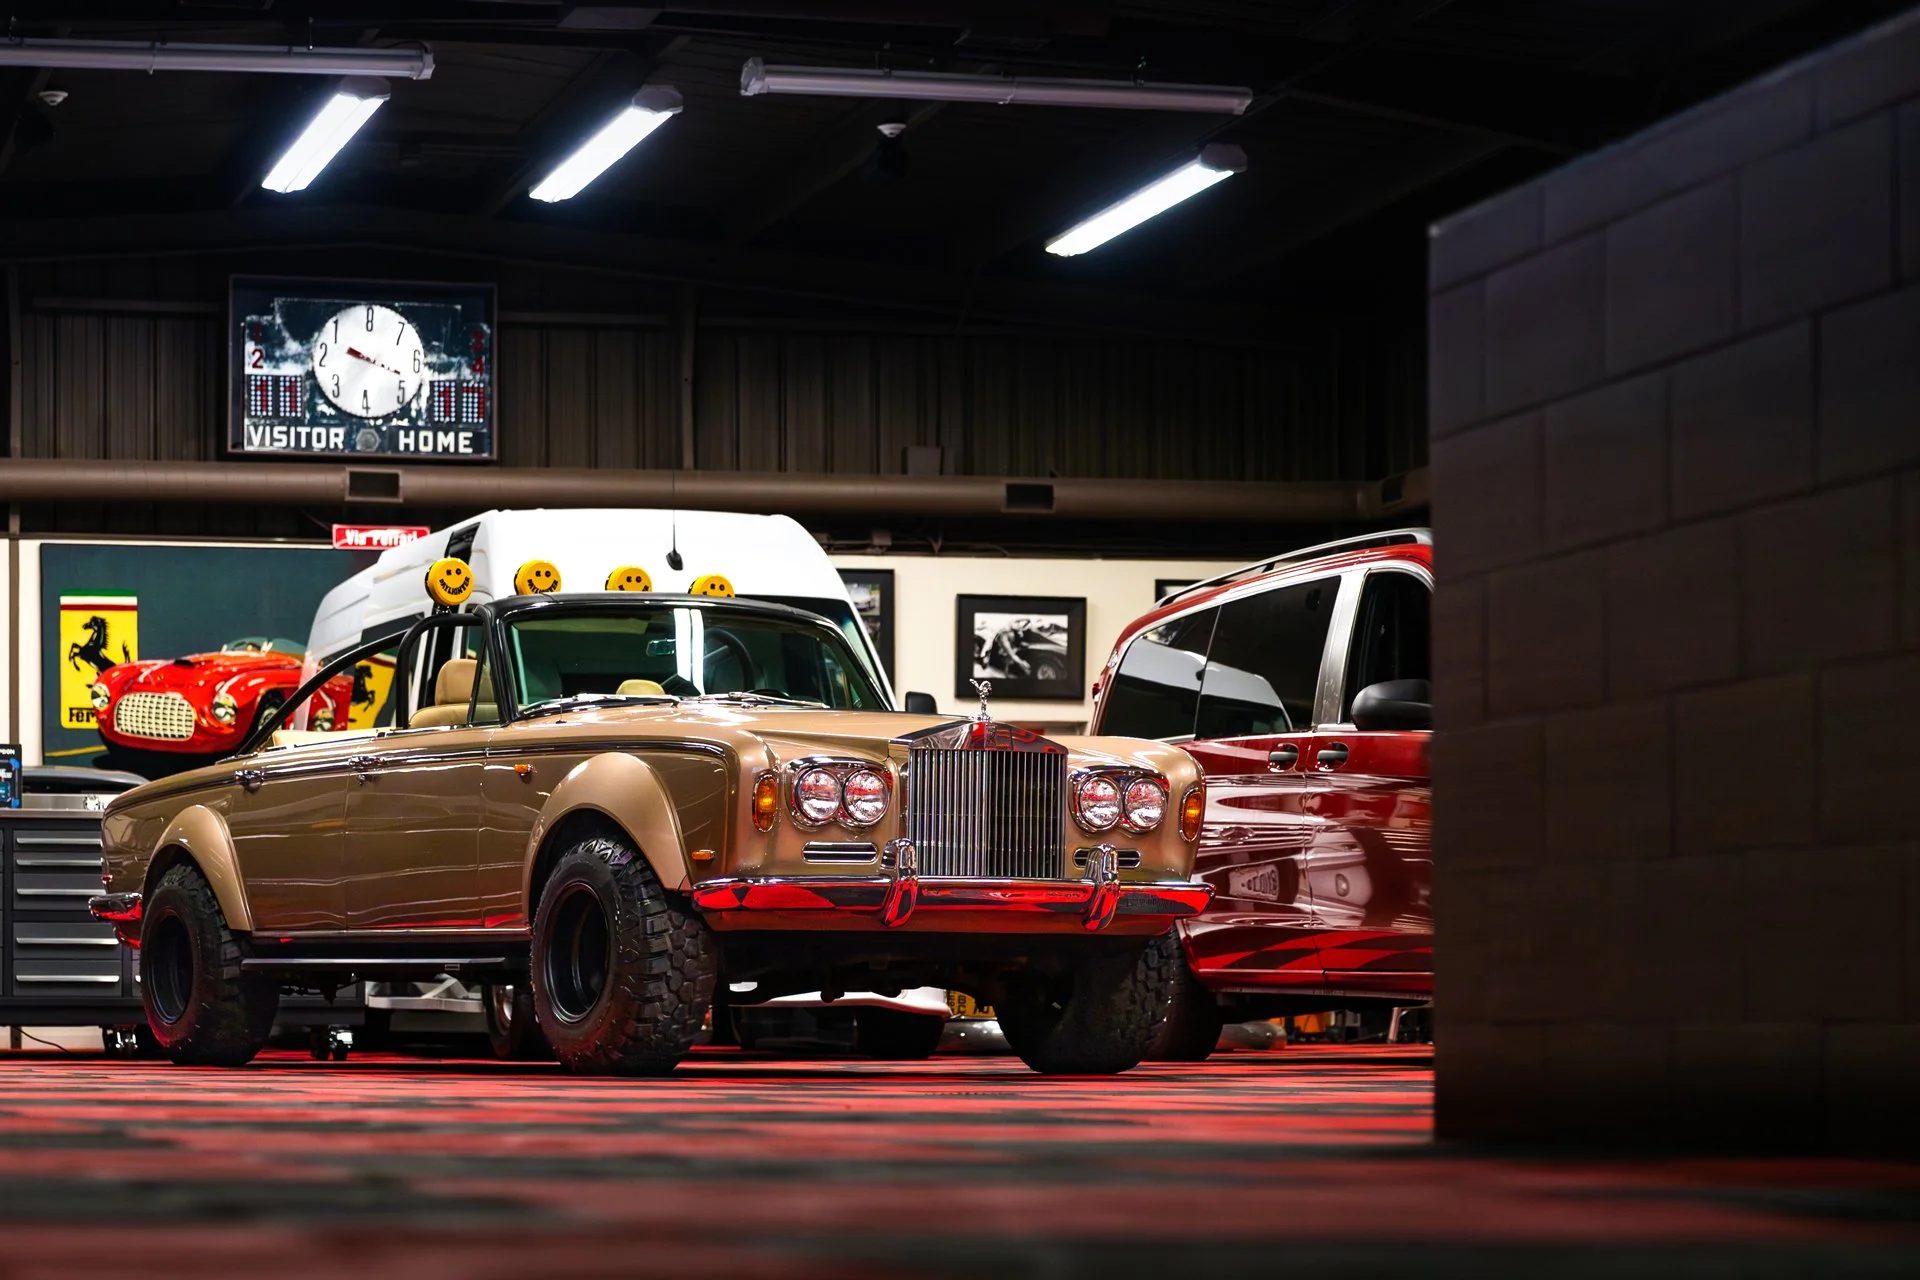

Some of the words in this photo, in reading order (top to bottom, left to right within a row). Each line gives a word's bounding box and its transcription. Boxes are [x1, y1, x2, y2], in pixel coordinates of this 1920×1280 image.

[333, 318, 339, 344] 1
[366, 306, 374, 332] 8
[396, 321, 405, 346] 7
[252, 349, 264, 369] 2
[318, 342, 328, 367] 2
[413, 349, 420, 373] 6
[472, 356, 485, 376] 4
[332, 374, 340, 398] 3
[397, 380, 406, 405] 5
[361, 389, 371, 415] 4
[249, 425, 345, 449] VISITOR
[399, 429, 473, 453] HOME
